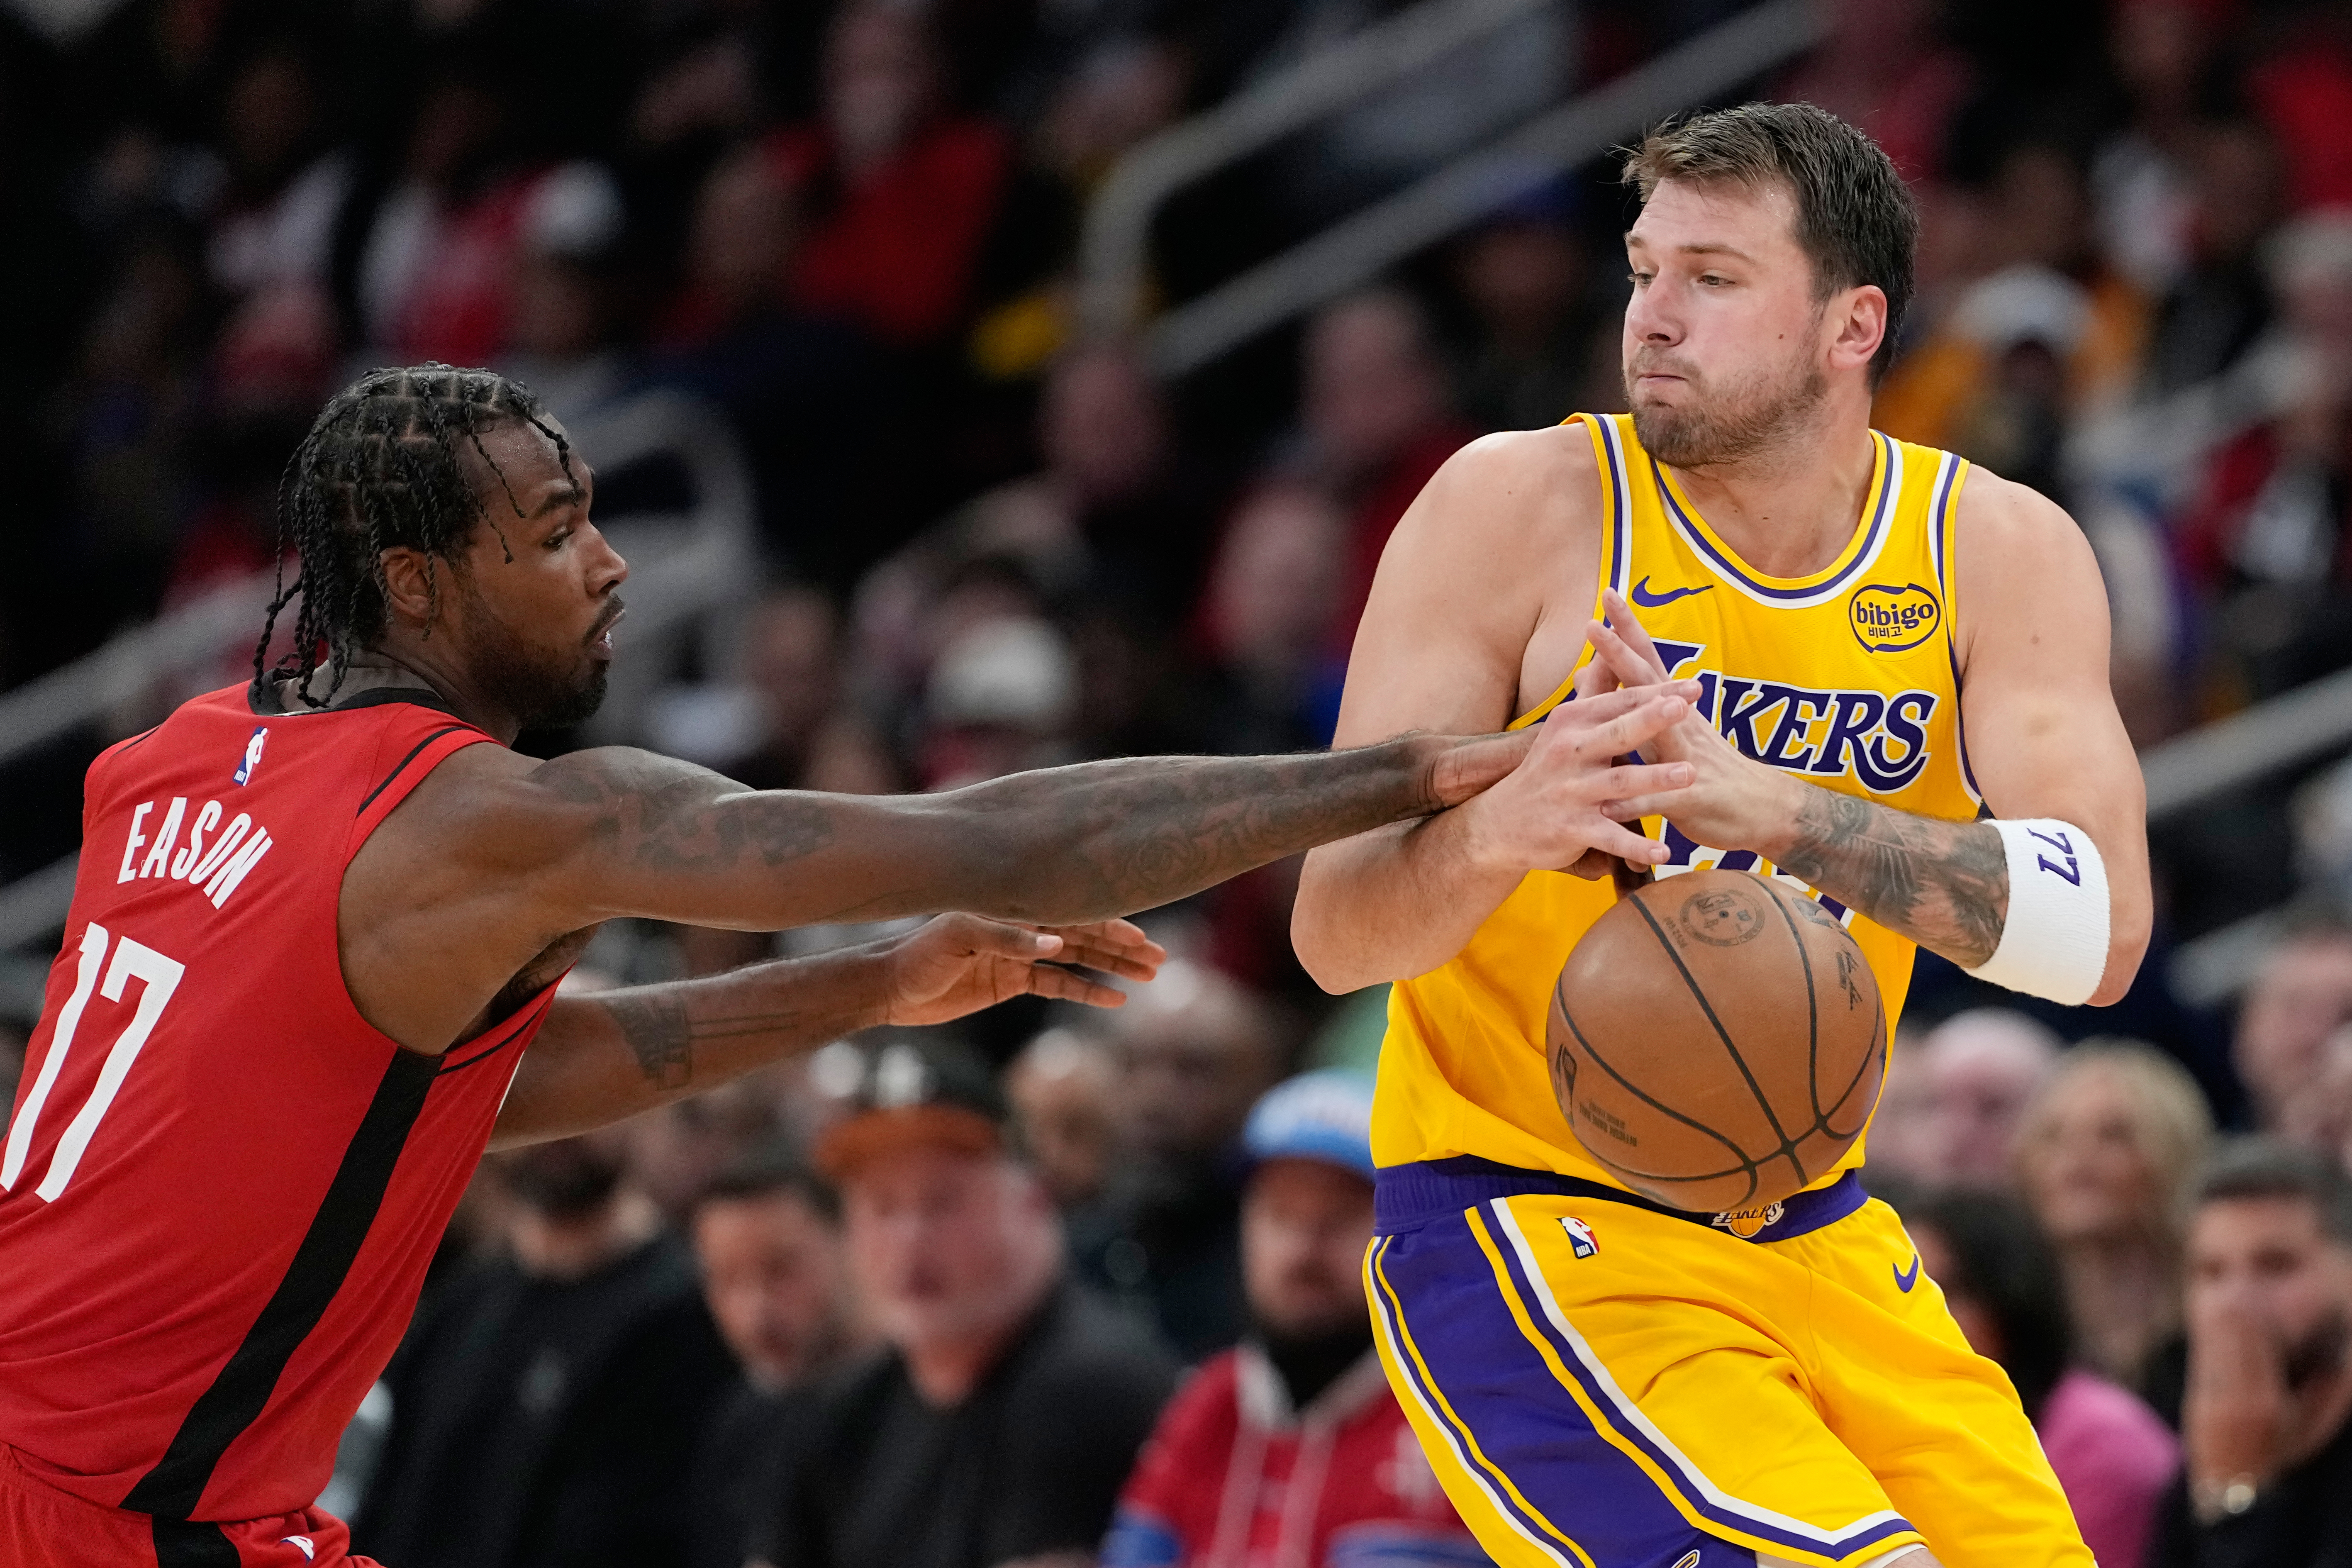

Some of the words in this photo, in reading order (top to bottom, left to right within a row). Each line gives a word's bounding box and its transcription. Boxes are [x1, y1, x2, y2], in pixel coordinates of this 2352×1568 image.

[1856, 601, 1934, 629] bibigo
[1868, 626, 1902, 638] 비비고
[1628, 637, 1940, 794] AKERS
[234, 770, 246, 783] NBA
[117, 797, 273, 910] EASON
[2026, 827, 2080, 887] 77
[0, 922, 185, 1203] 17
[1575, 1244, 1592, 1257] NBA
